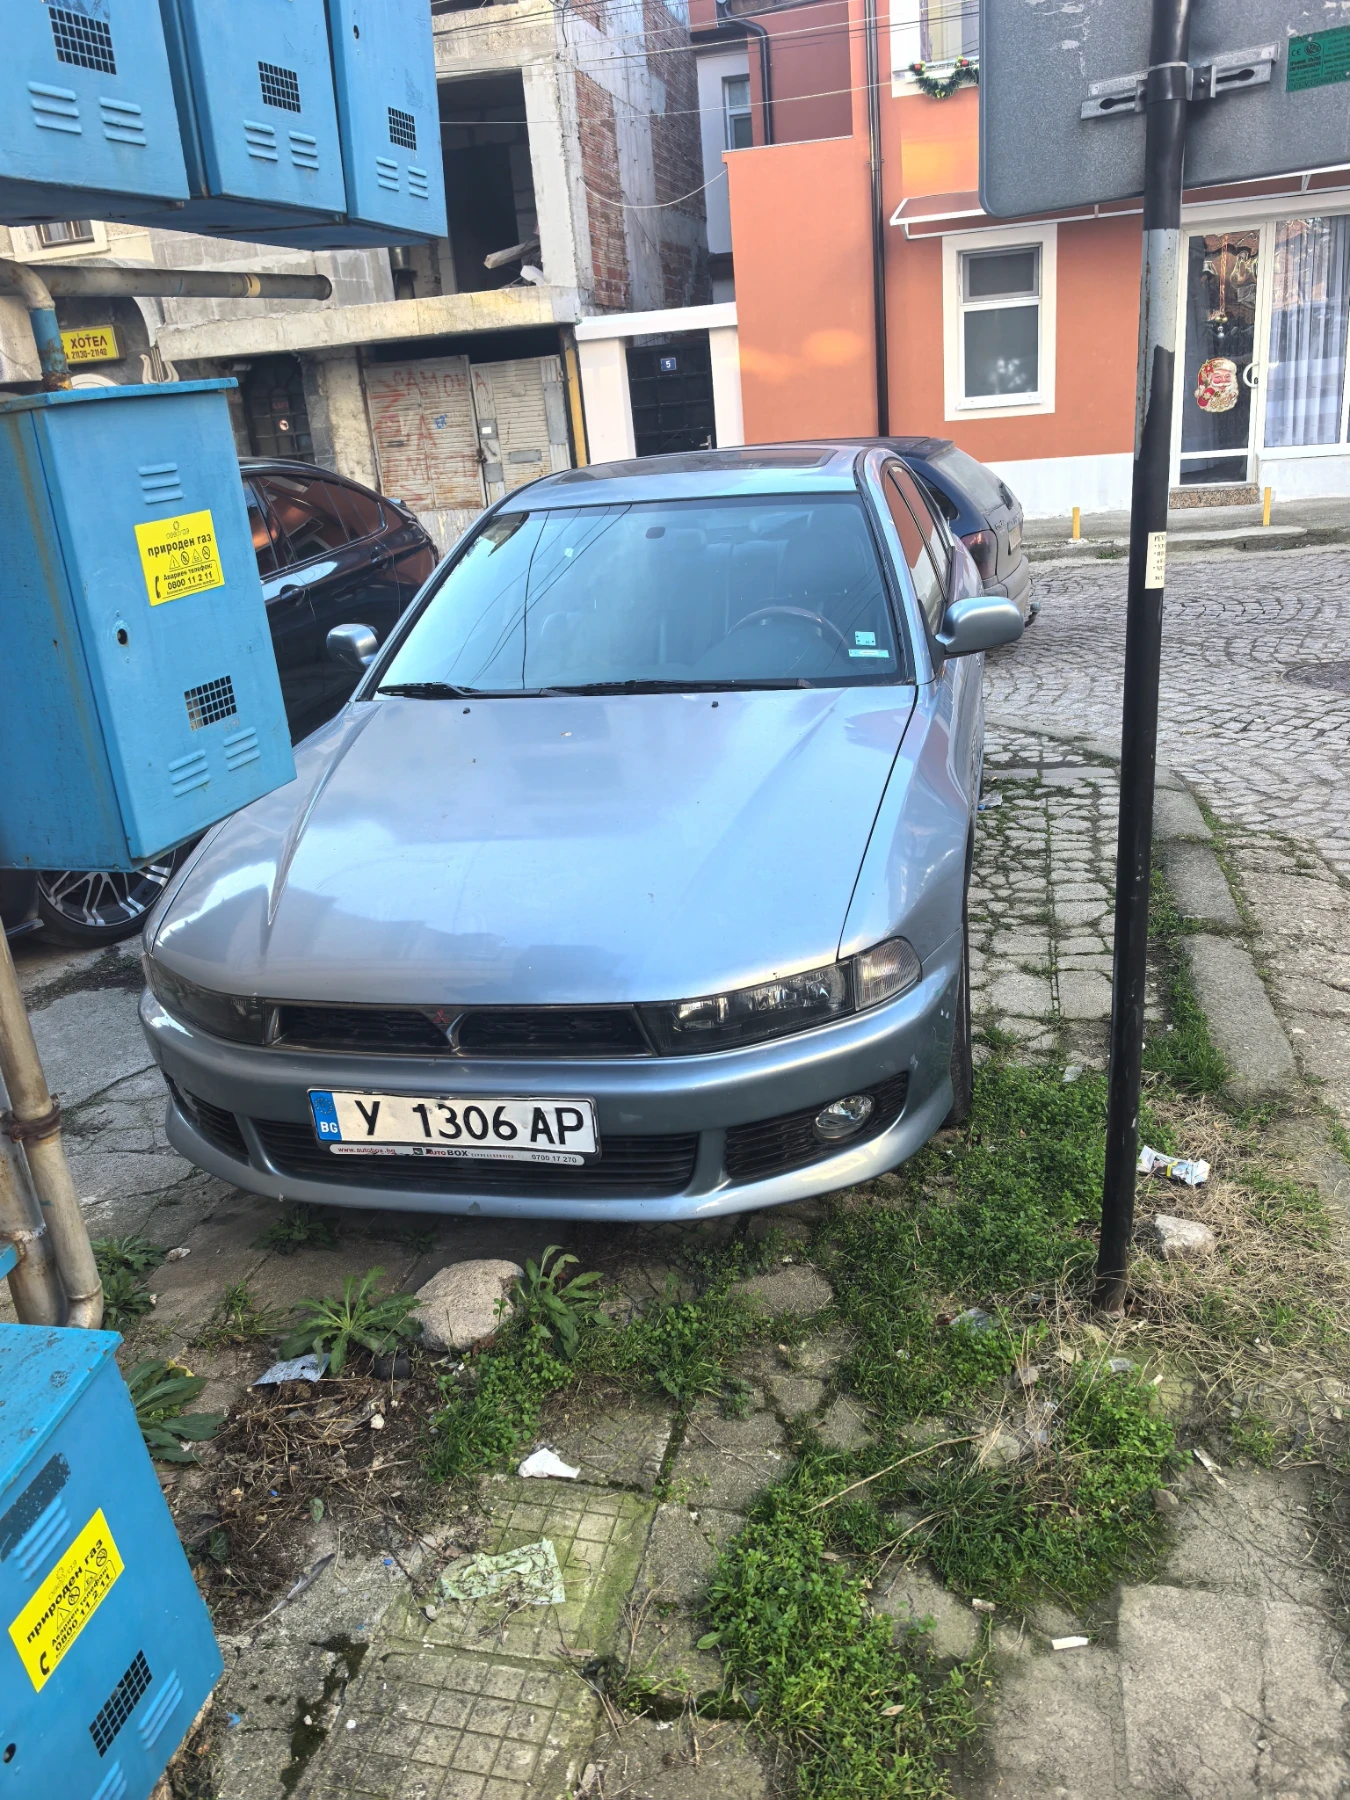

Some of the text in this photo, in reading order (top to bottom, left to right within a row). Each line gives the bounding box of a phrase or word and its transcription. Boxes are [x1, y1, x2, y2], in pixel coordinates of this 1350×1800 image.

[70, 335, 108, 350] ХОТЕЛ
[665, 360, 671, 369] 5
[147, 533, 212, 558] природен газ
[167, 578, 186, 590] 0800
[187, 576, 196, 585] 11
[197, 574, 203, 582] 2
[204, 571, 213, 580] 11
[320, 1121, 338, 1133] BG
[412, 1103, 518, 1140] 1306
[530, 1106, 584, 1145] AP
[26, 1566, 83, 1644] природен
[84, 1539, 103, 1566] газ
[55, 1619, 78, 1651] 0800
[80, 1601, 91, 1616] 11
[92, 1590, 98, 1600] 2
[100, 1573, 110, 1587] 11
[52, 1608, 79, 1646] Авариен
